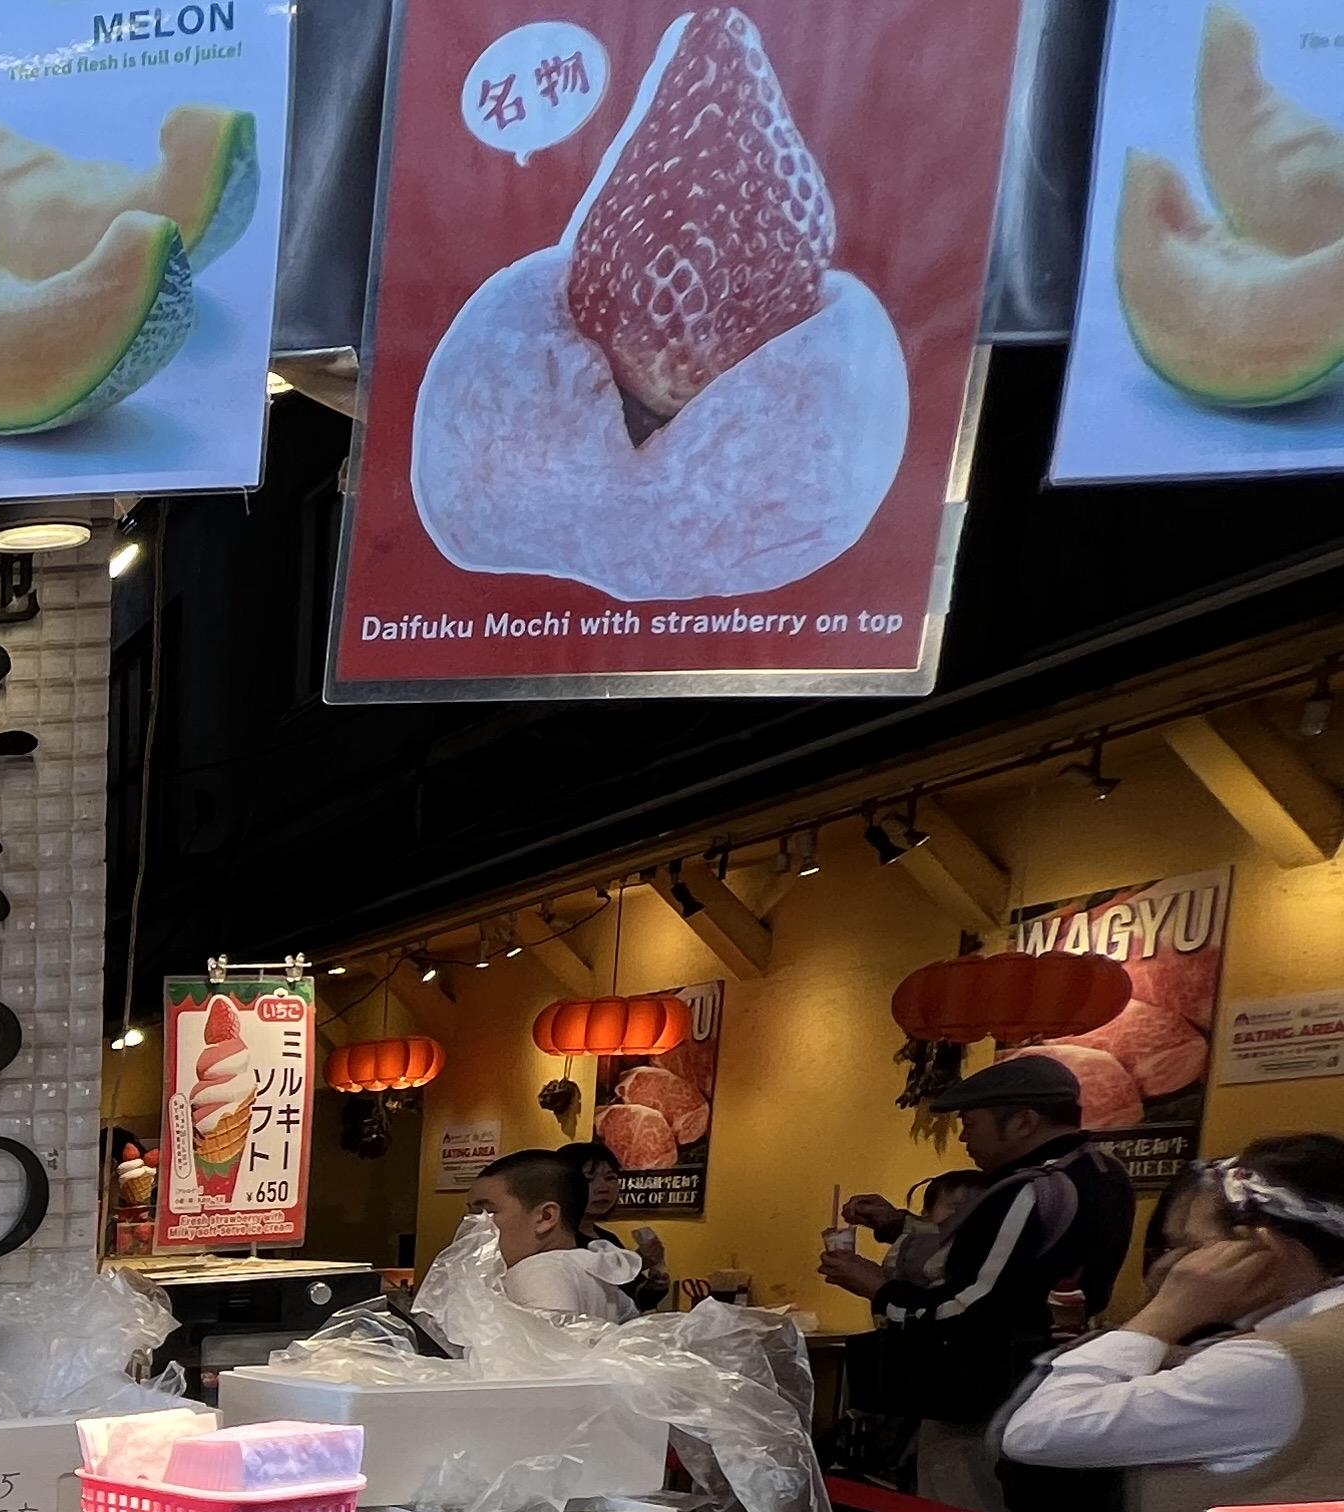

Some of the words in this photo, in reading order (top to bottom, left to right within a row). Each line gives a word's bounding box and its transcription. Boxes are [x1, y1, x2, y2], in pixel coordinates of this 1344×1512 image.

[92, 2, 236, 46] MELON
[44, 59, 72, 76] red
[77, 54, 118, 73] flesh
[122, 52, 137, 69] is
[140, 49, 170, 67] full
[174, 46, 192, 64] of
[475, 52, 591, 132] 名物
[362, 610, 475, 643] Daifuku
[484, 608, 572, 640] Mochi
[578, 606, 642, 639] with
[649, 604, 806, 641] strawberry
[815, 610, 850, 633] on
[857, 607, 904, 640] top
[1016, 886, 1214, 962] WAGYU
[263, 1003, 300, 1019] いちご
[249, 1068, 275, 1171] ソフト
[276, 1031, 303, 1171] ミルキー
[246, 1181, 289, 1203] ¥650
[649, 1192, 664, 1204] OF
[668, 1191, 698, 1203] BEEF
[0, 1472, 21, 1499] 5
